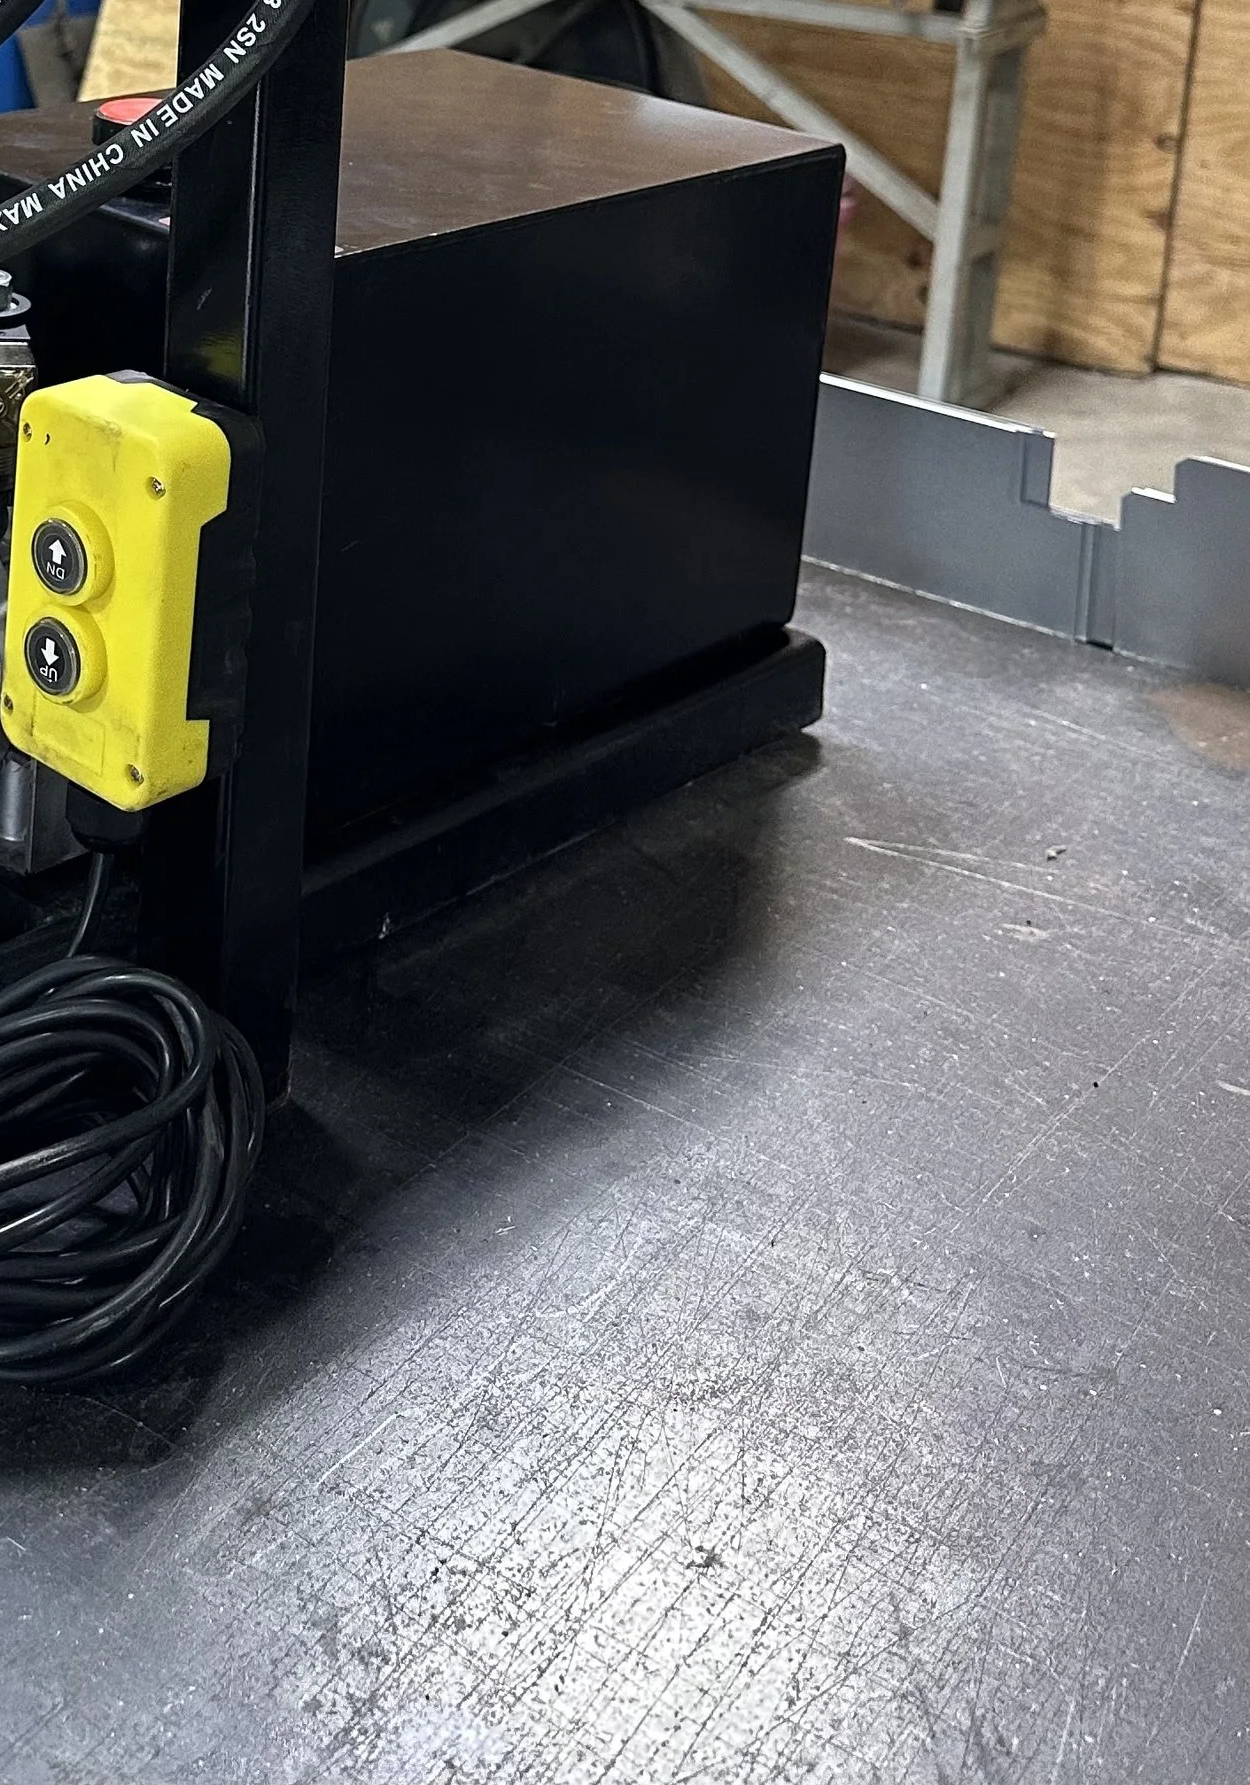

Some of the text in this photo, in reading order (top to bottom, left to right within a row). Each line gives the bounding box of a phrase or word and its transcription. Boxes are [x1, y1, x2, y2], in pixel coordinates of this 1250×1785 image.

[223, 13, 266, 63] 2SN
[156, 63, 225, 128] MADE
[130, 118, 160, 147] IN
[48, 144, 124, 200] CHINA
[46, 561, 65, 580] DN
[39, 665, 58, 682] UP
